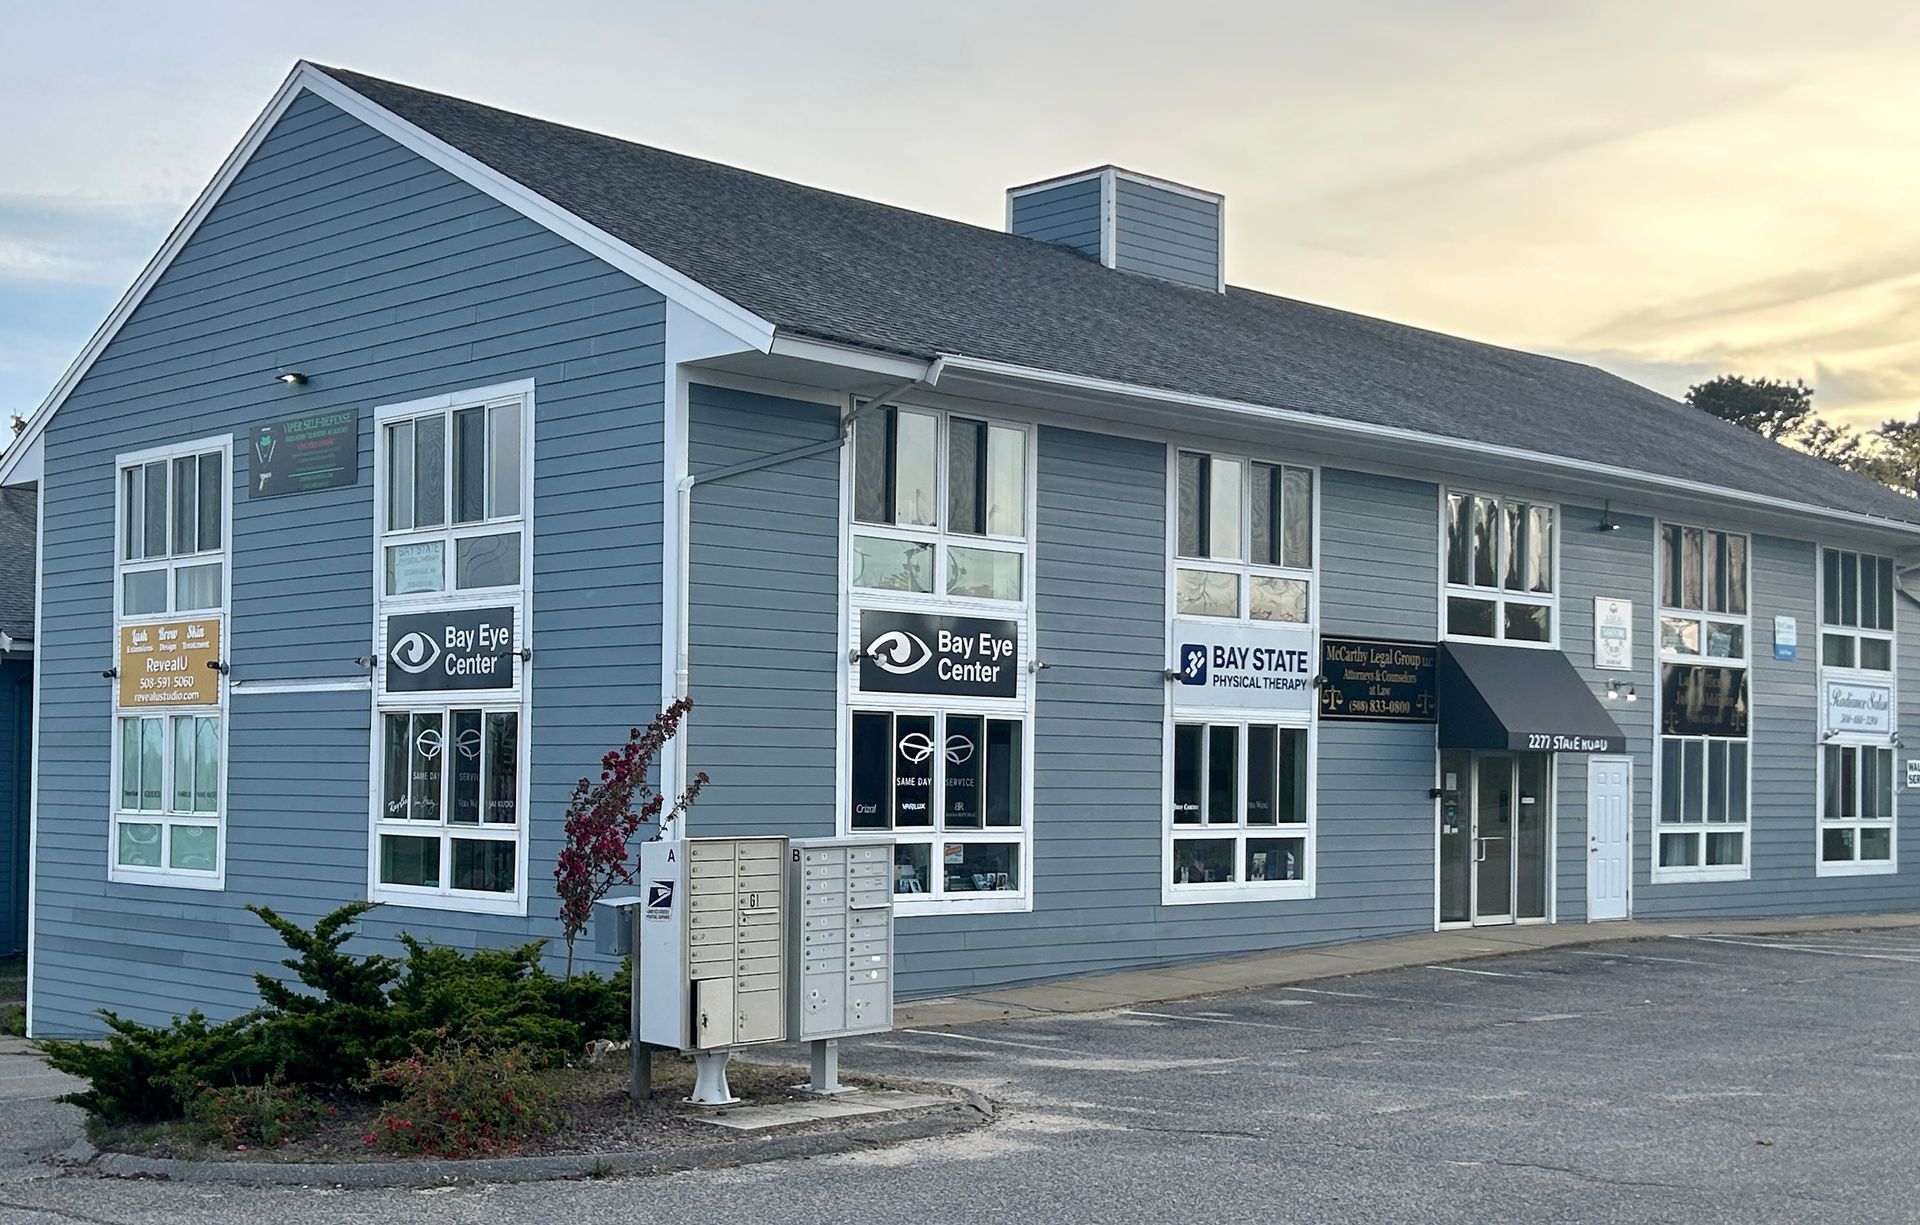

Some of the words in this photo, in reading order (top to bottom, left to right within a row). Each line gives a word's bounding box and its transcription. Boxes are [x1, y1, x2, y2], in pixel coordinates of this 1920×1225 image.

[131, 629, 148, 646] Lash
[158, 627, 178, 641] Brow
[186, 624, 205, 639] Skin
[445, 625, 475, 653] Bay
[479, 623, 509, 652] Eye
[159, 643, 177, 652] Design
[938, 630, 974, 659] Bay
[979, 633, 1013, 661] Eye
[146, 656, 188, 672] RevealU
[444, 653, 498, 676] Center
[1213, 645, 1249, 670] BAY
[1253, 648, 1308, 673] STATE
[1326, 645, 1368, 666] McCarthy
[1370, 649, 1393, 667] Legal
[1394, 650, 1421, 670] Group
[937, 658, 1000, 683] Center
[1343, 668, 1375, 683] Attorneys
[1375, 669, 1381, 682] &
[139, 675, 194, 689] 508-591-5060
[1212, 674, 1261, 689] PHYSICAL
[1263, 677, 1307, 691] THERAPY
[134, 691, 199, 702] revealustudio.com
[1368, 686, 1376, 696] at
[1377, 684, 1391, 696] Law
[1348, 700, 1368, 714] (508)
[1369, 699, 1410, 714] 833-0800
[1528, 734, 1551, 749] 2277
[413, 771, 428, 780] SAME
[896, 777, 916, 786] SAME
[918, 777, 932, 786] DAY
[945, 778, 975, 787] SERVICE
[667, 848, 676, 862] A
[792, 848, 800, 862] B
